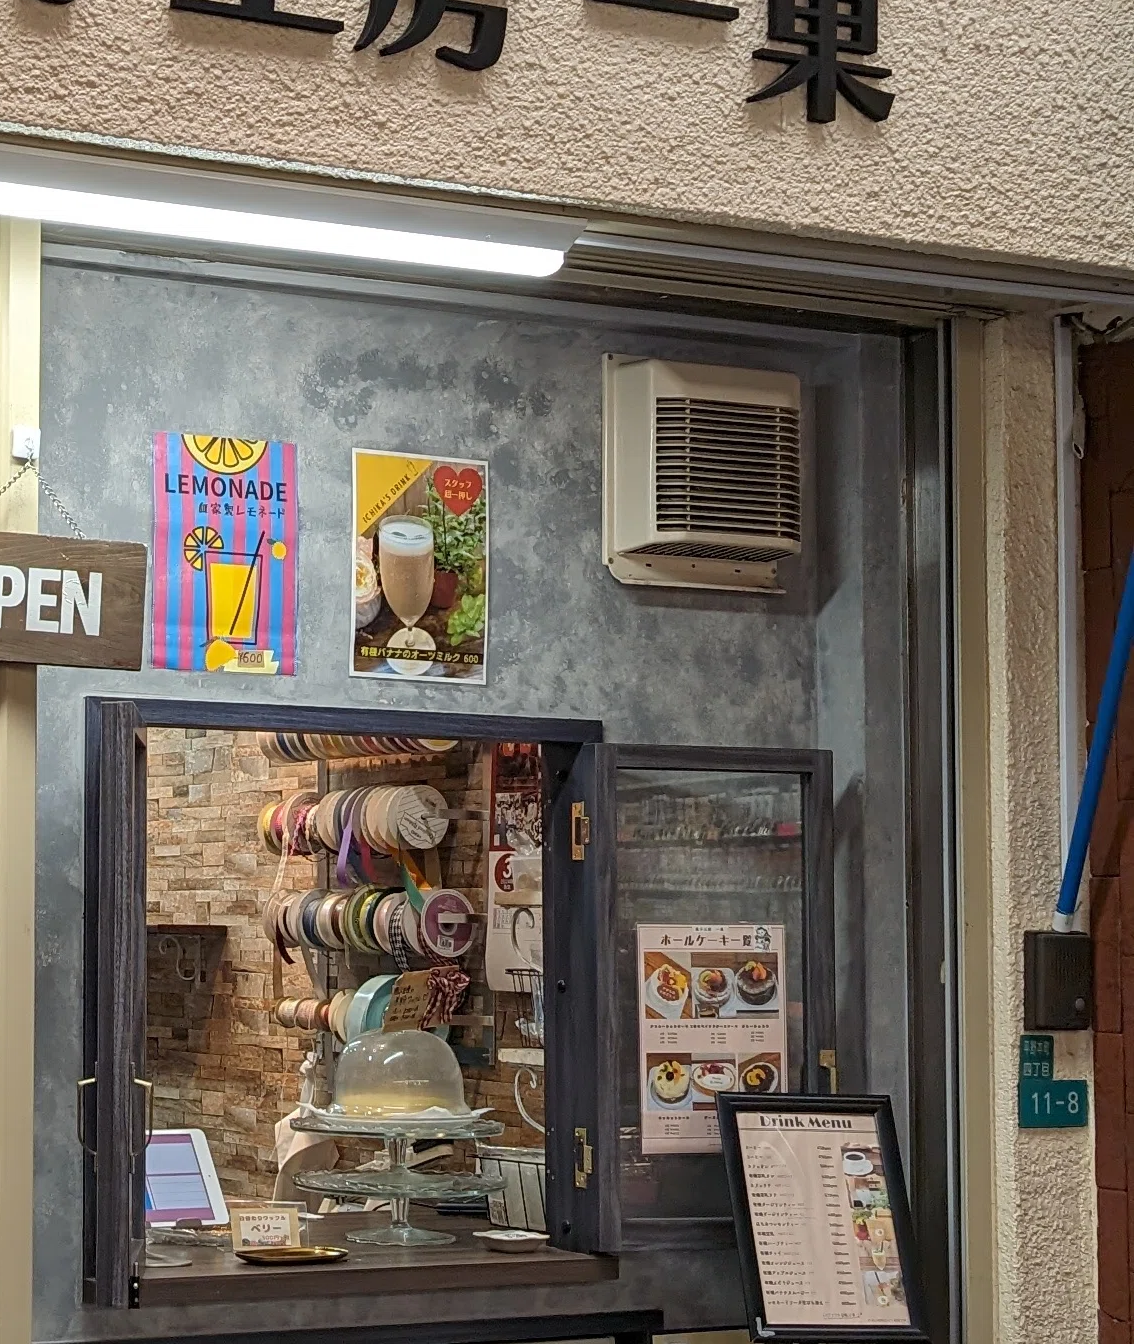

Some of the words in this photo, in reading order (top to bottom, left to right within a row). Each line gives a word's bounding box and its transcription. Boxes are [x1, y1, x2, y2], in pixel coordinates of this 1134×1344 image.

[165, 473, 287, 502] LEMONADE
[363, 492, 392, 523] ICHIKA'S
[391, 475, 411, 497] DRINK
[198, 502, 286, 519] 自家製レモネード
[361, 646, 460, 663] 有機バナナのオーツミルク
[463, 653, 479, 664] 600
[660, 934, 751, 947] ホールケーキ一覧
[1031, 1091, 1079, 1115] 11-8
[759, 1114, 805, 1128] Drink
[807, 1116, 853, 1129] Menu
[251, 1223, 282, 1233] ベリー
